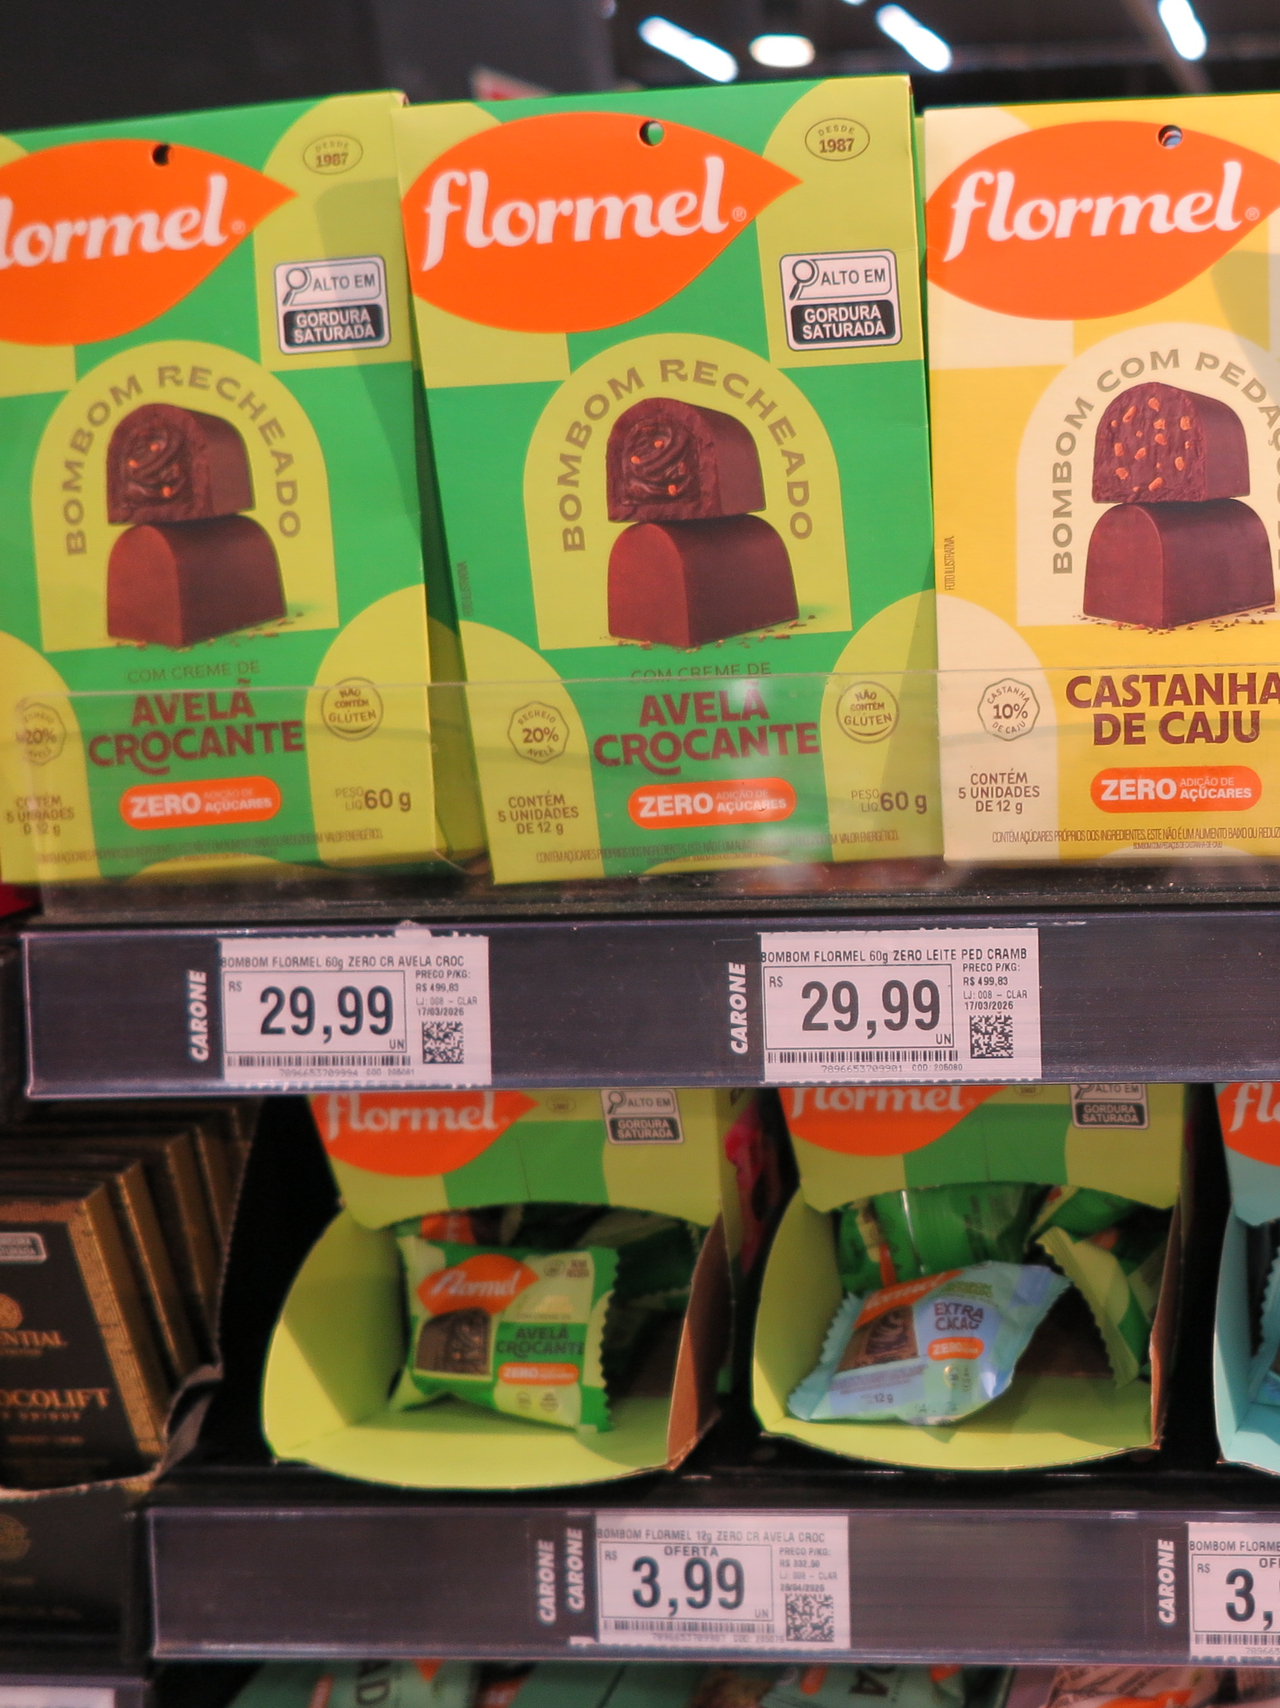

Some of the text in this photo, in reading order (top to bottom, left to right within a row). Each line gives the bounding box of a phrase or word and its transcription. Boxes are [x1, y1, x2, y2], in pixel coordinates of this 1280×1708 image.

[0, 172, 228, 270] lormel
[422, 155, 730, 271] flormel
[943, 161, 1242, 262] flormel
[820, 267, 887, 287] ALTO EM
[804, 305, 881, 324] GORDURA
[802, 319, 887, 340] SATURADA
[62, 363, 302, 556] BOMBOM RECHEADO
[558, 358, 814, 552] BOMBOM RECHEADO
[1052, 396, 1097, 575] BOMBOM
[1096, 348, 1180, 394] COM
[131, 678, 256, 728] AVELÃ
[639, 680, 769, 728] AVELÃ
[992, 702, 1029, 720] 10%
[521, 726, 559, 745] 20%
[1093, 711, 1260, 746] DE CAJU
[88, 720, 304, 776] CROCANTE
[593, 721, 821, 776] CROCANTE
[970, 769, 1028, 787] CONTÉM
[1101, 777, 1177, 802] ZERO
[130, 792, 201, 819] ZERO
[639, 792, 714, 818] ZERO
[958, 784, 1041, 800] 5 UNIDADES
[1180, 786, 1253, 802] AÇÚCARES
[974, 800, 1024, 815] DE 12 g
[221, 956, 464, 971] BOMBOM FLORMEL 60g ZERO CR AVELA CROC
[761, 948, 1027, 964] BOMBOM FLORMEL 60g ZERO LEITE PED CRAMB
[963, 963, 1021, 972] PRECO P/KG:
[187, 969, 210, 1063] CARONE
[260, 985, 393, 1044] 29,99
[729, 963, 748, 1054] CARONE
[801, 979, 941, 1040] 29,99
[965, 1001, 1014, 1010] 17/03/2026
[327, 1092, 499, 1141] flormel
[934, 1302, 984, 1323] EXTRA
[935, 1317, 979, 1331] CACAU
[664, 1546, 719, 1557] OFERTA
[1189, 1541, 1236, 1552] BOMBOM
[566, 1527, 585, 1613] CARONE
[1157, 1539, 1176, 1626] CARONE
[632, 1556, 745, 1617] 3,99
